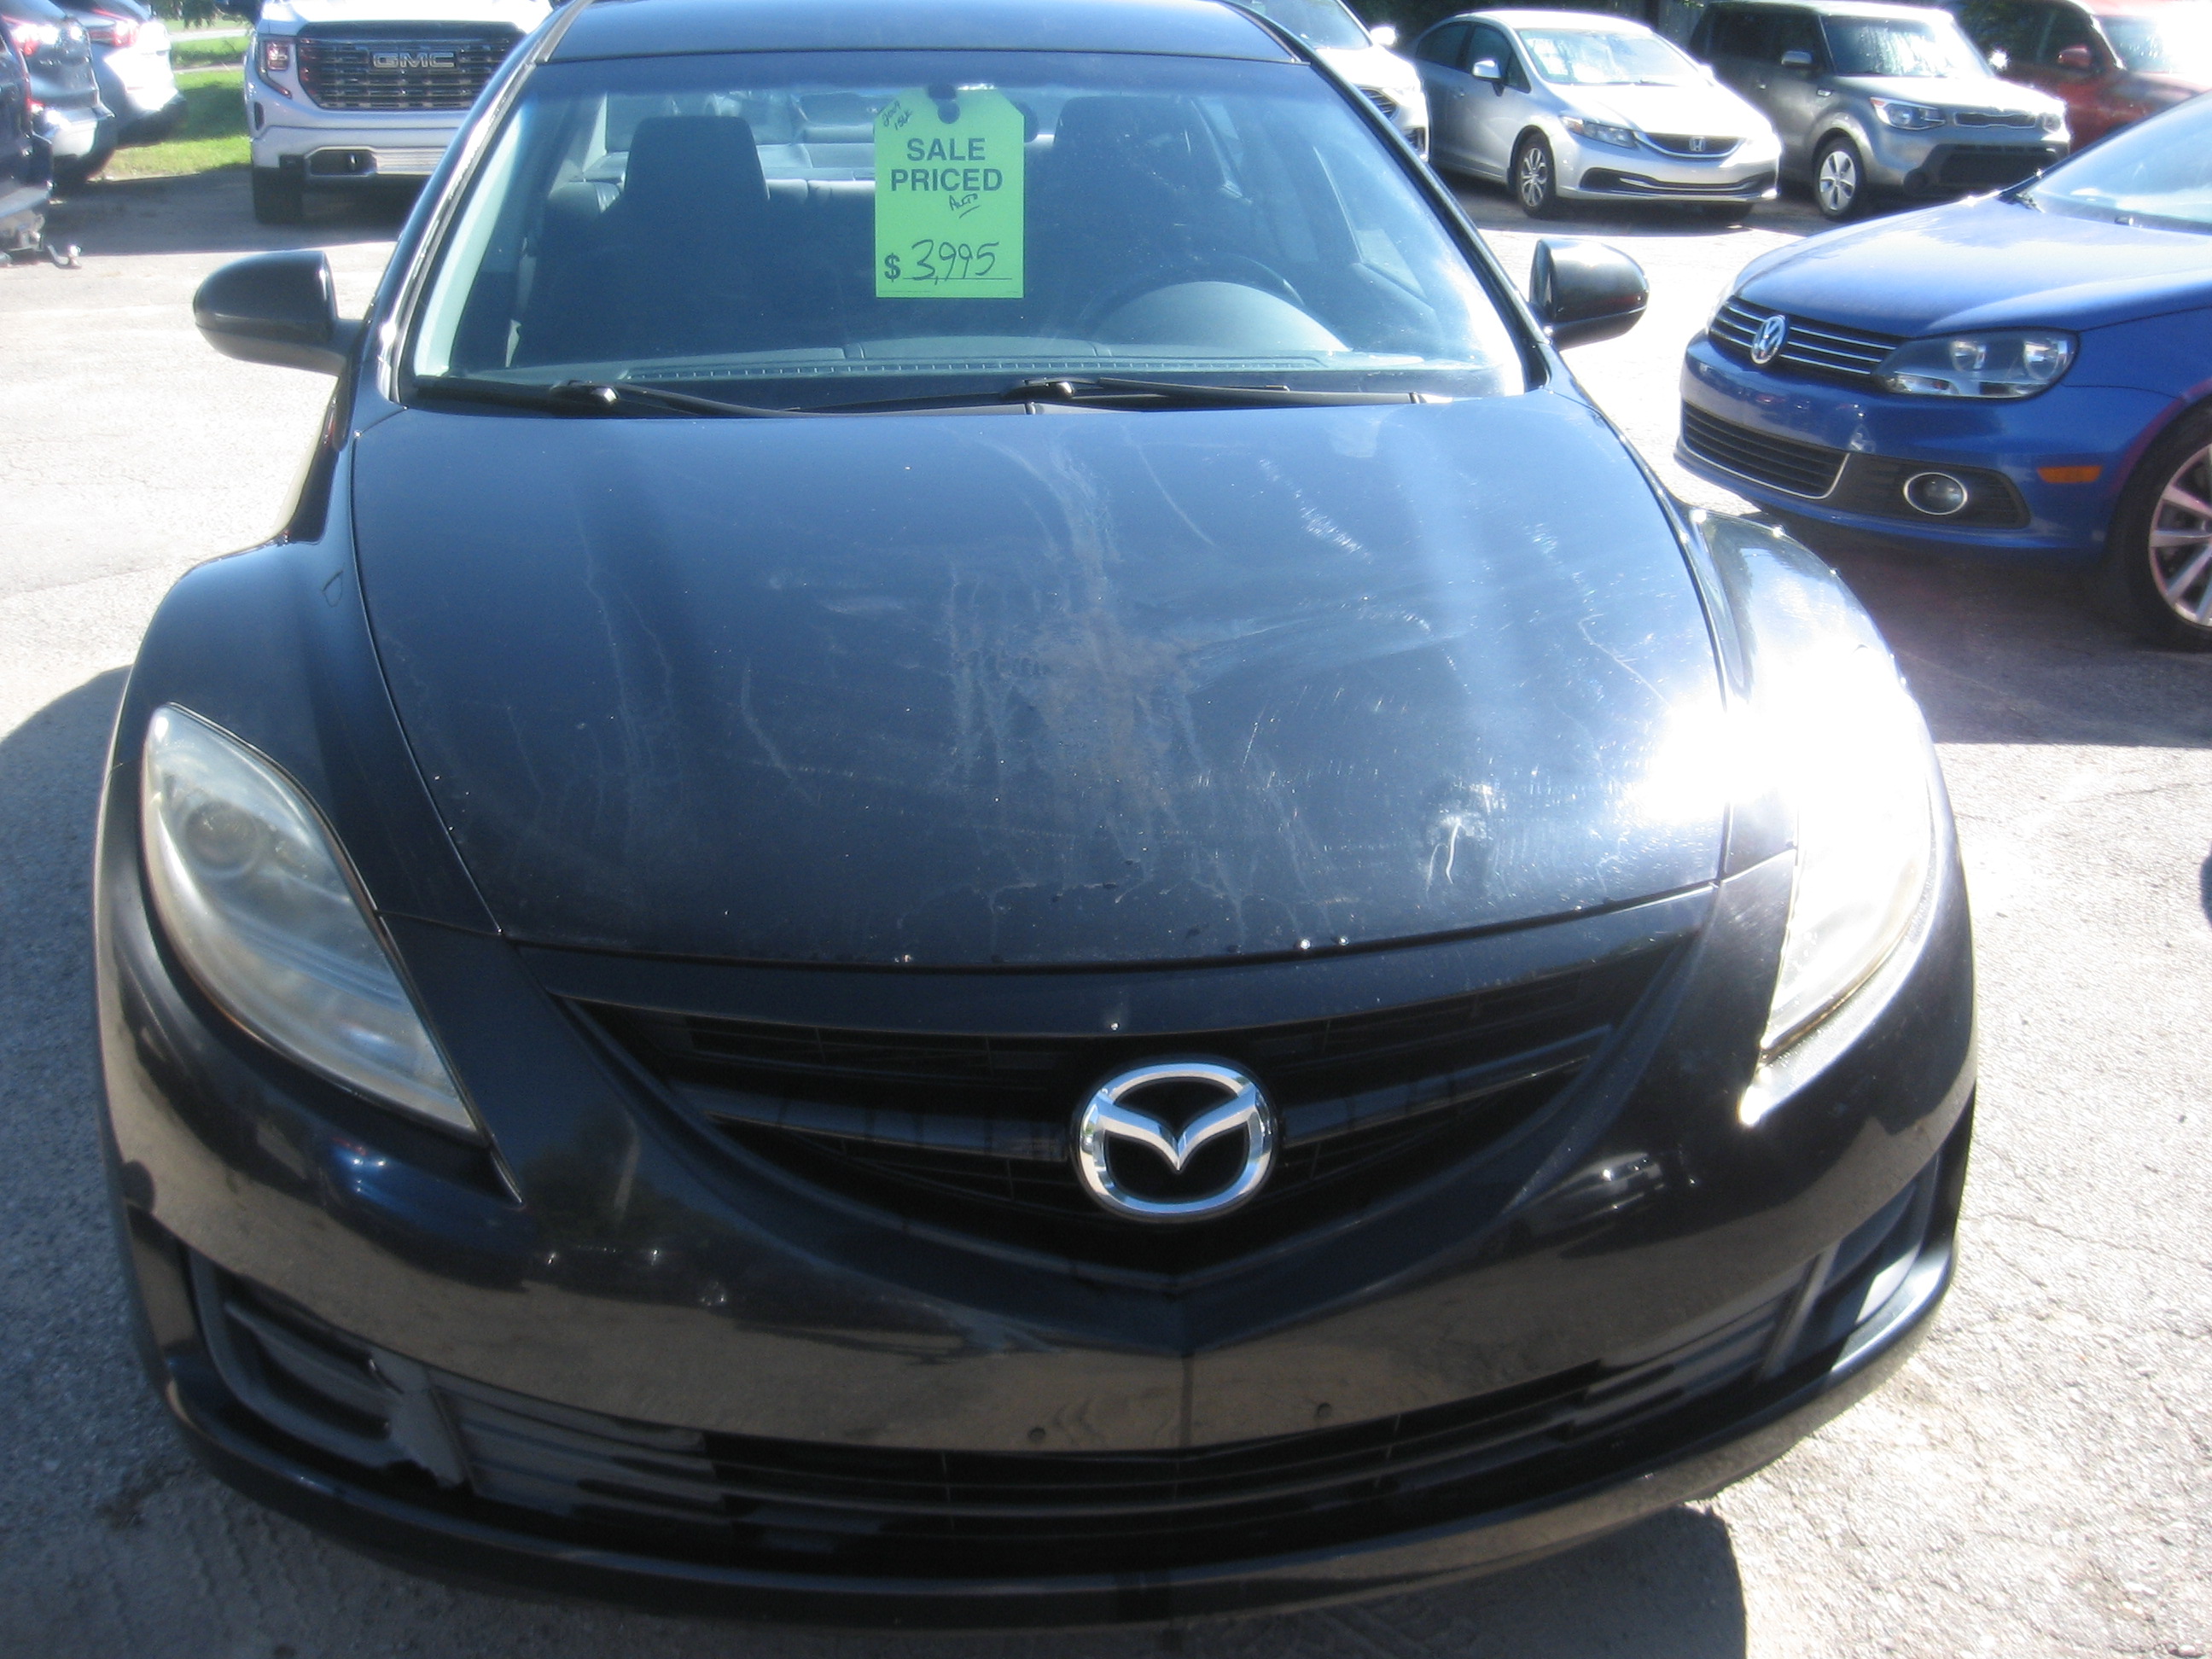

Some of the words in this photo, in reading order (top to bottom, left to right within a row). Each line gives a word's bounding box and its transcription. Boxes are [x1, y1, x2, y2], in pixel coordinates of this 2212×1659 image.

[373, 52, 455, 68] GMC
[906, 137, 986, 161] SALE
[891, 168, 1003, 192] PRICED
